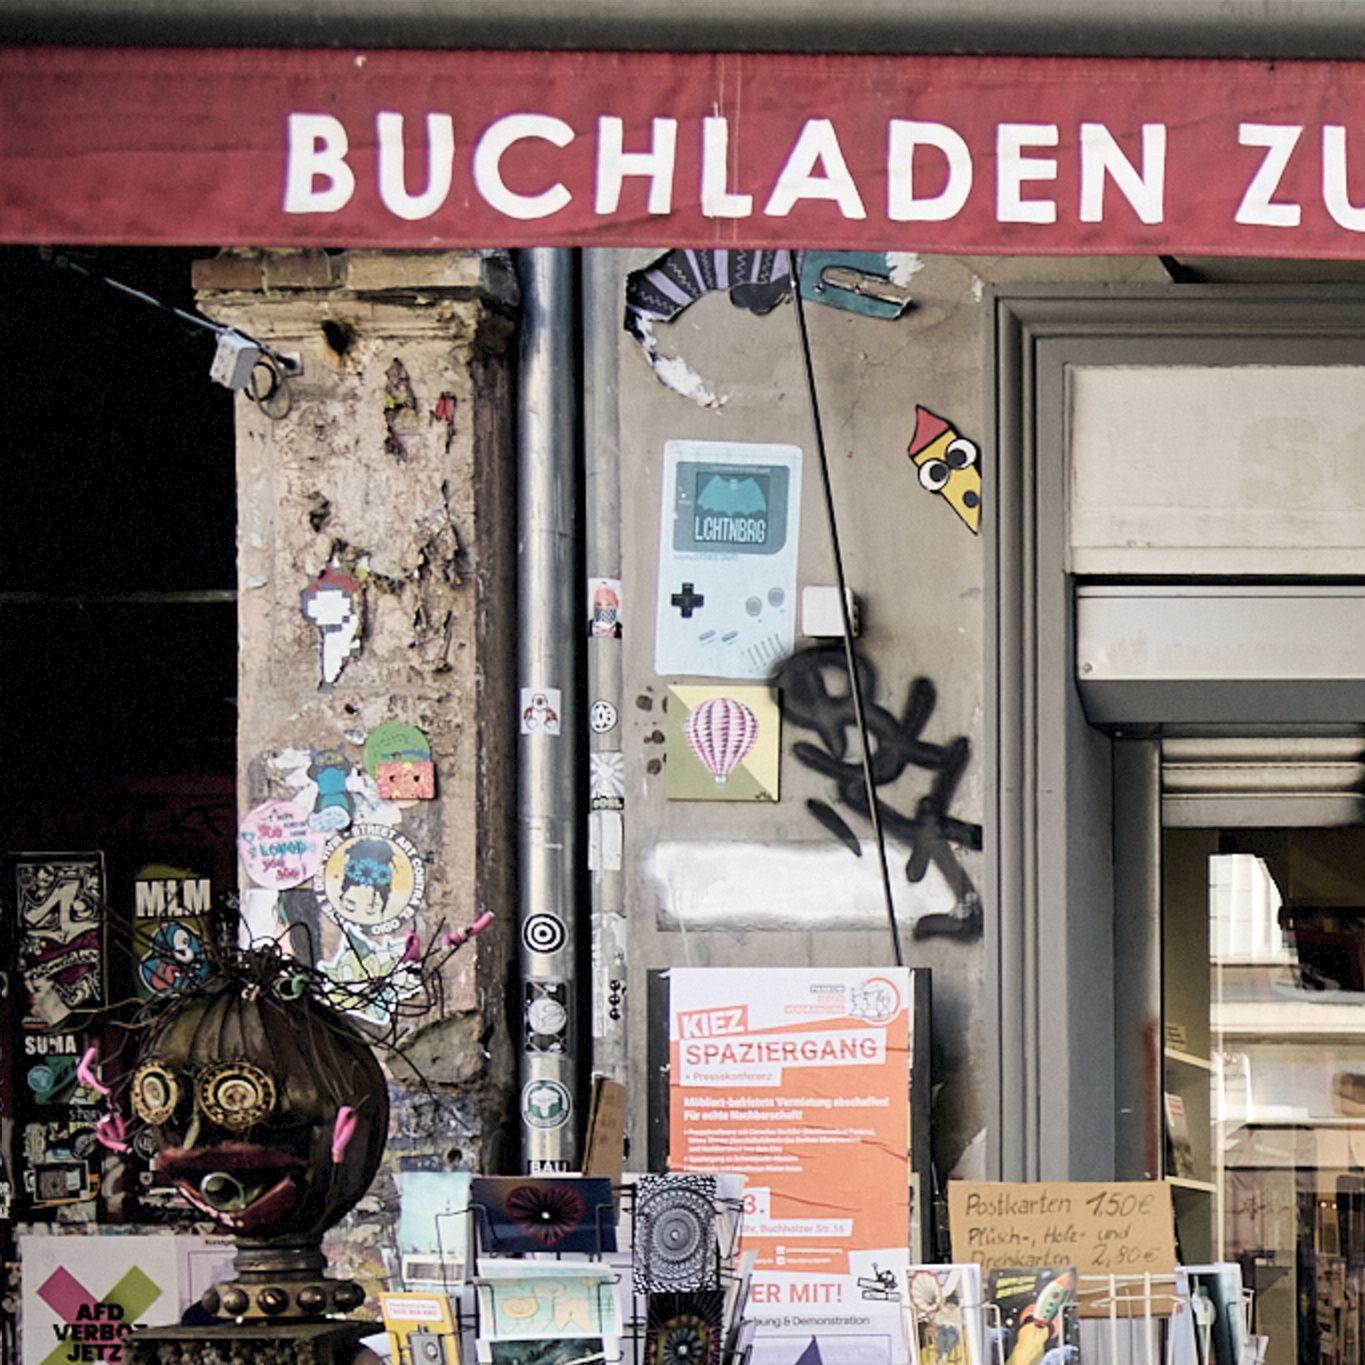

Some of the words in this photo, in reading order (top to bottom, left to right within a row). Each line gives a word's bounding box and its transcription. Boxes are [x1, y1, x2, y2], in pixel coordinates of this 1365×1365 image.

[283, 112, 1170, 223] BUCHLADEN
[694, 515, 767, 544] LCHTNBRG
[681, 1008, 746, 1040] KIEZ
[685, 1036, 879, 1066] SPAZIERGANG
[693, 1071, 773, 1083] Pressekonferenz
[964, 1189, 1072, 1217] Postkarten
[1097, 1223, 1132, 1242] und
[789, 1283, 843, 1304] MIT!
[75, 1302, 125, 1321] AFD
[792, 1314, 871, 1327] Demonstration
[52, 1323, 149, 1342] VERBO
